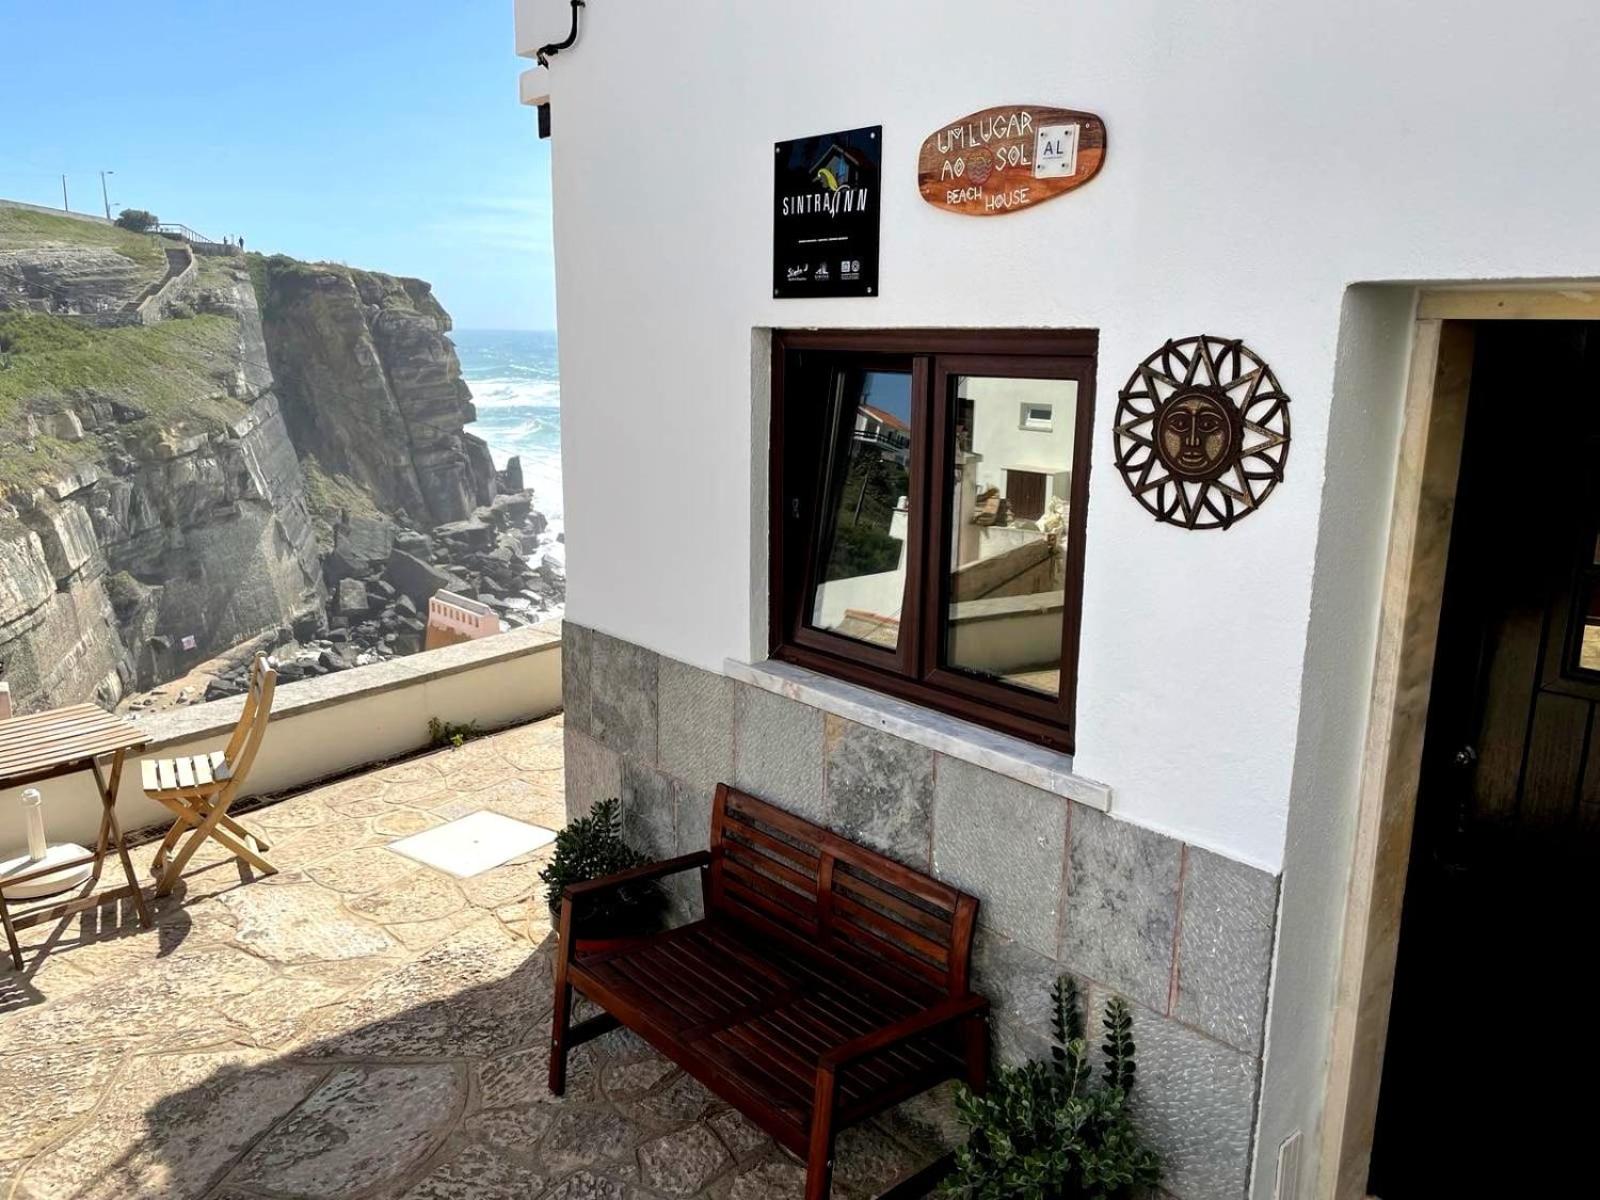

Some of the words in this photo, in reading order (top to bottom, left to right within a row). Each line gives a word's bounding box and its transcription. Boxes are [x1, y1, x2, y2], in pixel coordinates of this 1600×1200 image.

[937, 127, 964, 154] UM
[969, 111, 1033, 148] LUGAR
[1043, 139, 1064, 156] AL
[941, 157, 966, 181] AO
[995, 144, 1032, 171] SOL
[782, 192, 831, 216] SINTRA
[946, 186, 982, 205] BEACH
[985, 187, 1031, 211] HOUSE
